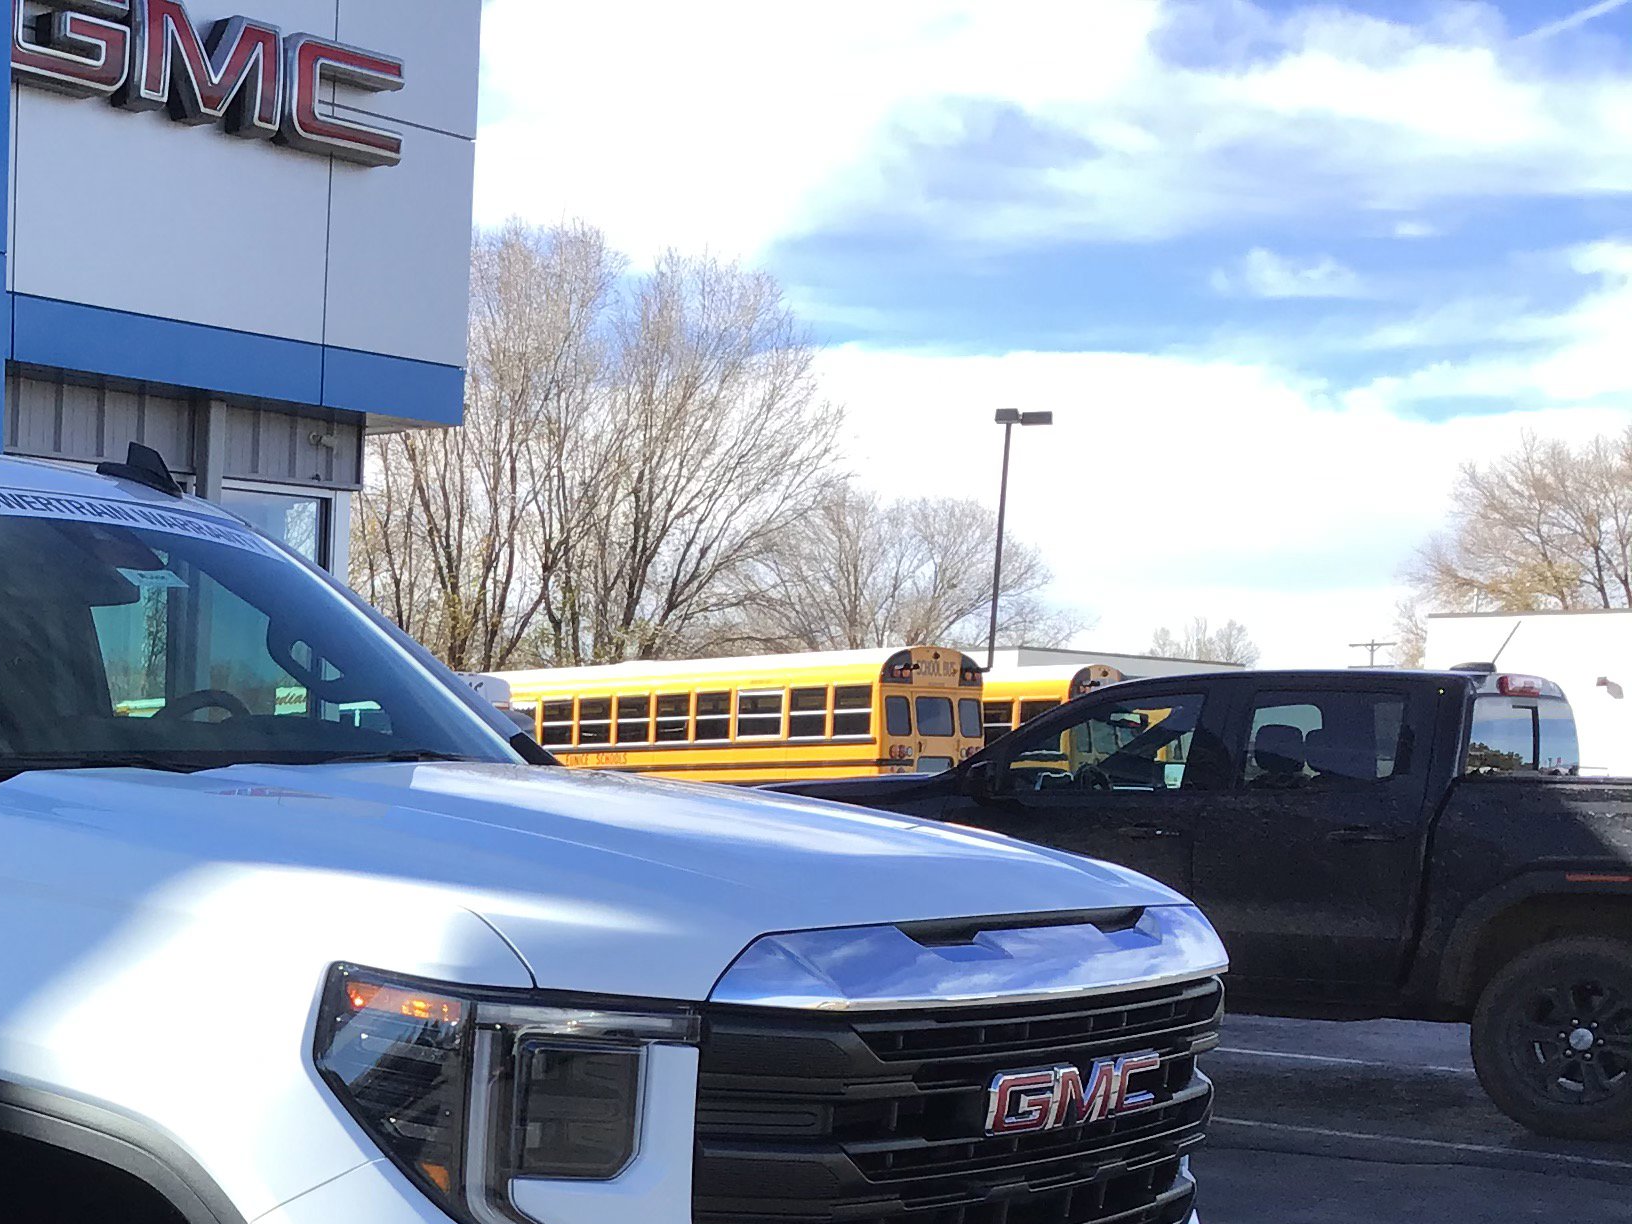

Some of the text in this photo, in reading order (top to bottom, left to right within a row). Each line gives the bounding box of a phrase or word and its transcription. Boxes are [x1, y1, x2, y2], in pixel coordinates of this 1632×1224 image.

[11, 0, 405, 168] GMC
[132, 508, 267, 552] WARRANTY
[916, 659, 957, 676] SCHOOL BUS
[566, 751, 627, 766] EUNICE SCHOOLS
[985, 1050, 1161, 1137] GMC
